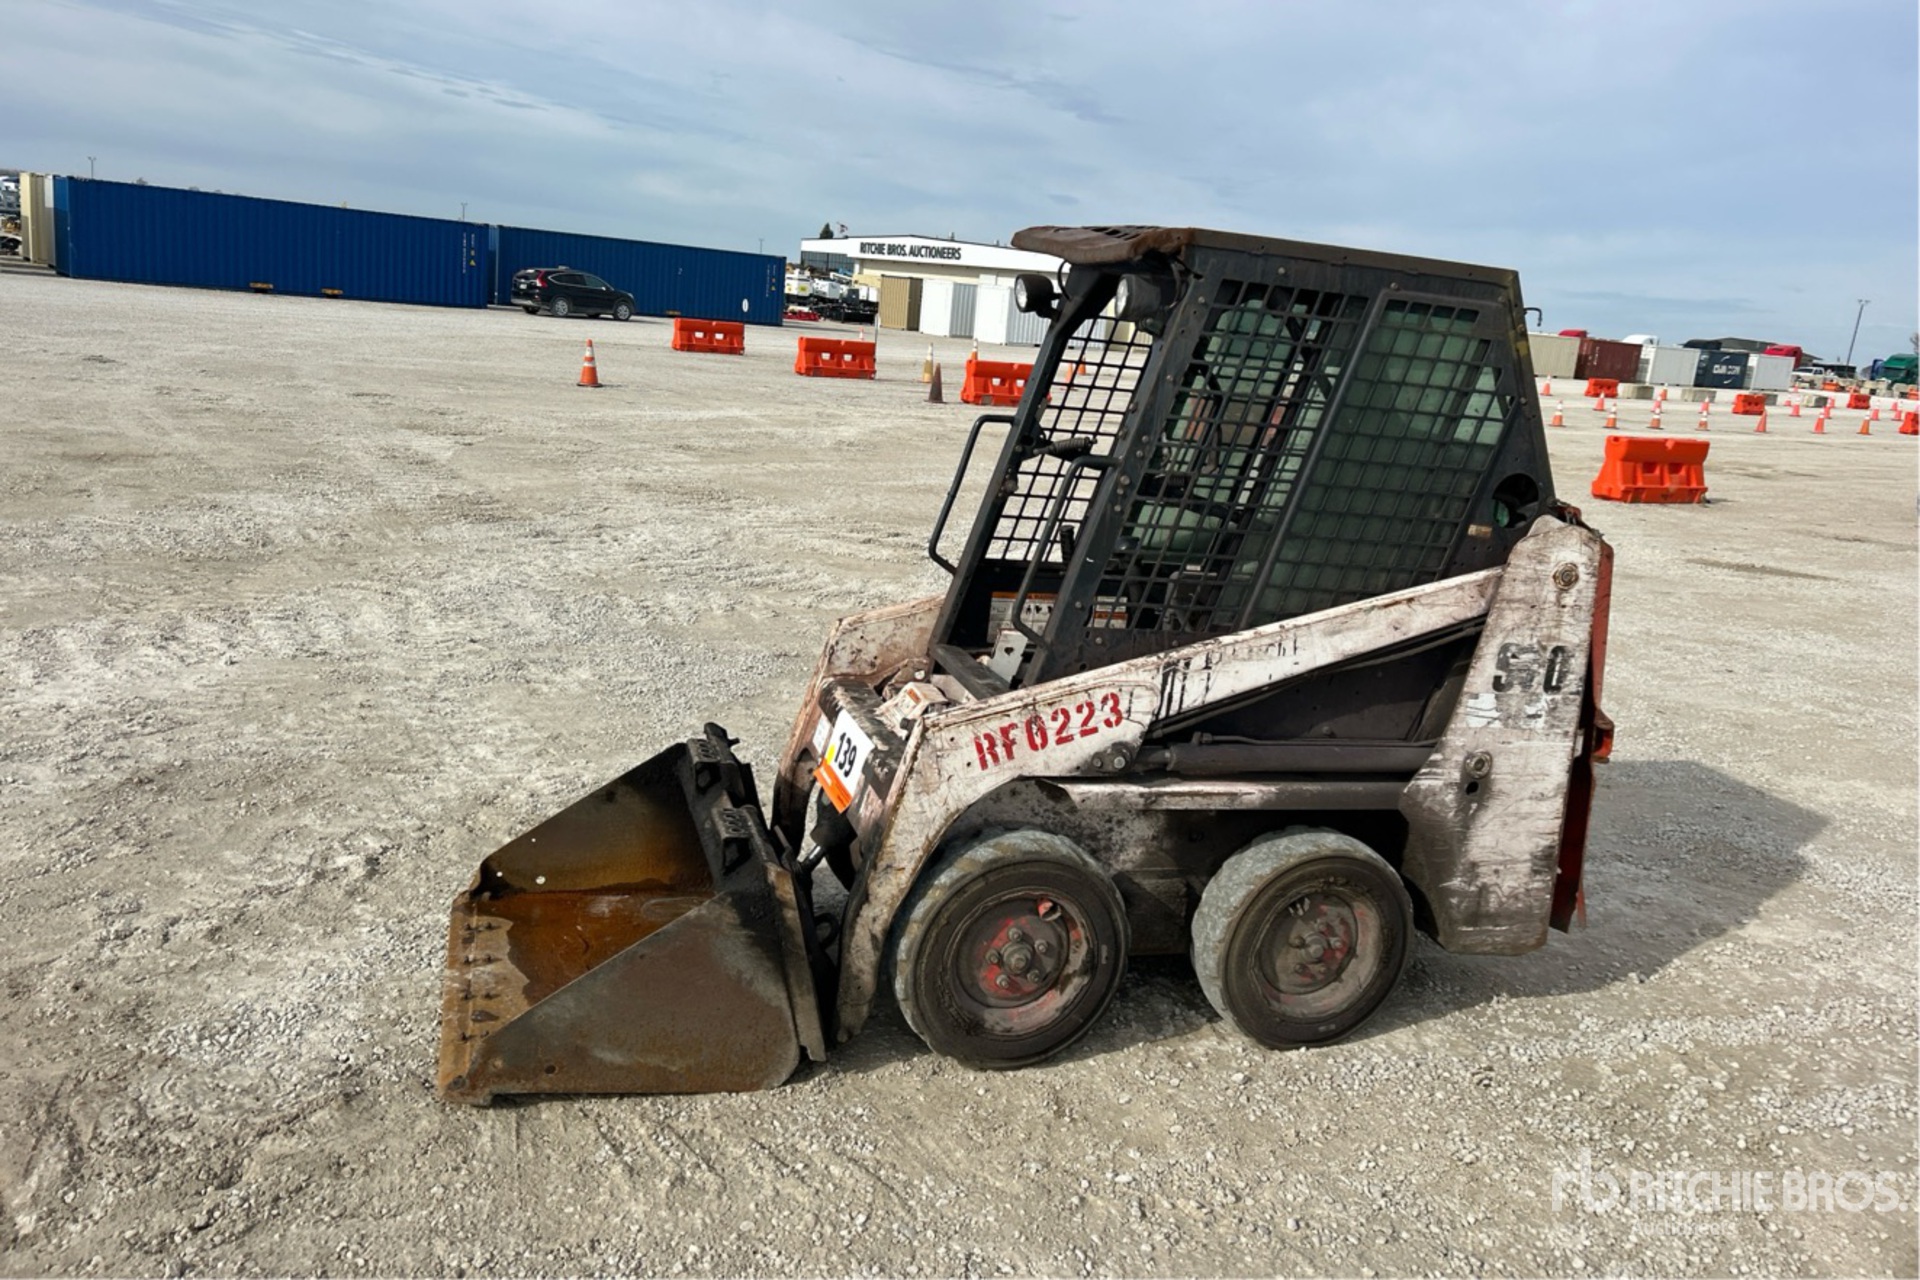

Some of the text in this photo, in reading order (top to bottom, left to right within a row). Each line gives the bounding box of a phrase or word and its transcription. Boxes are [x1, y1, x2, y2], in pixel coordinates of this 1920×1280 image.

[860, 242, 961, 260] RITCHIE BROS. AUCTIONEERS
[834, 731, 858, 778] 139
[973, 691, 1124, 771] RF0223
